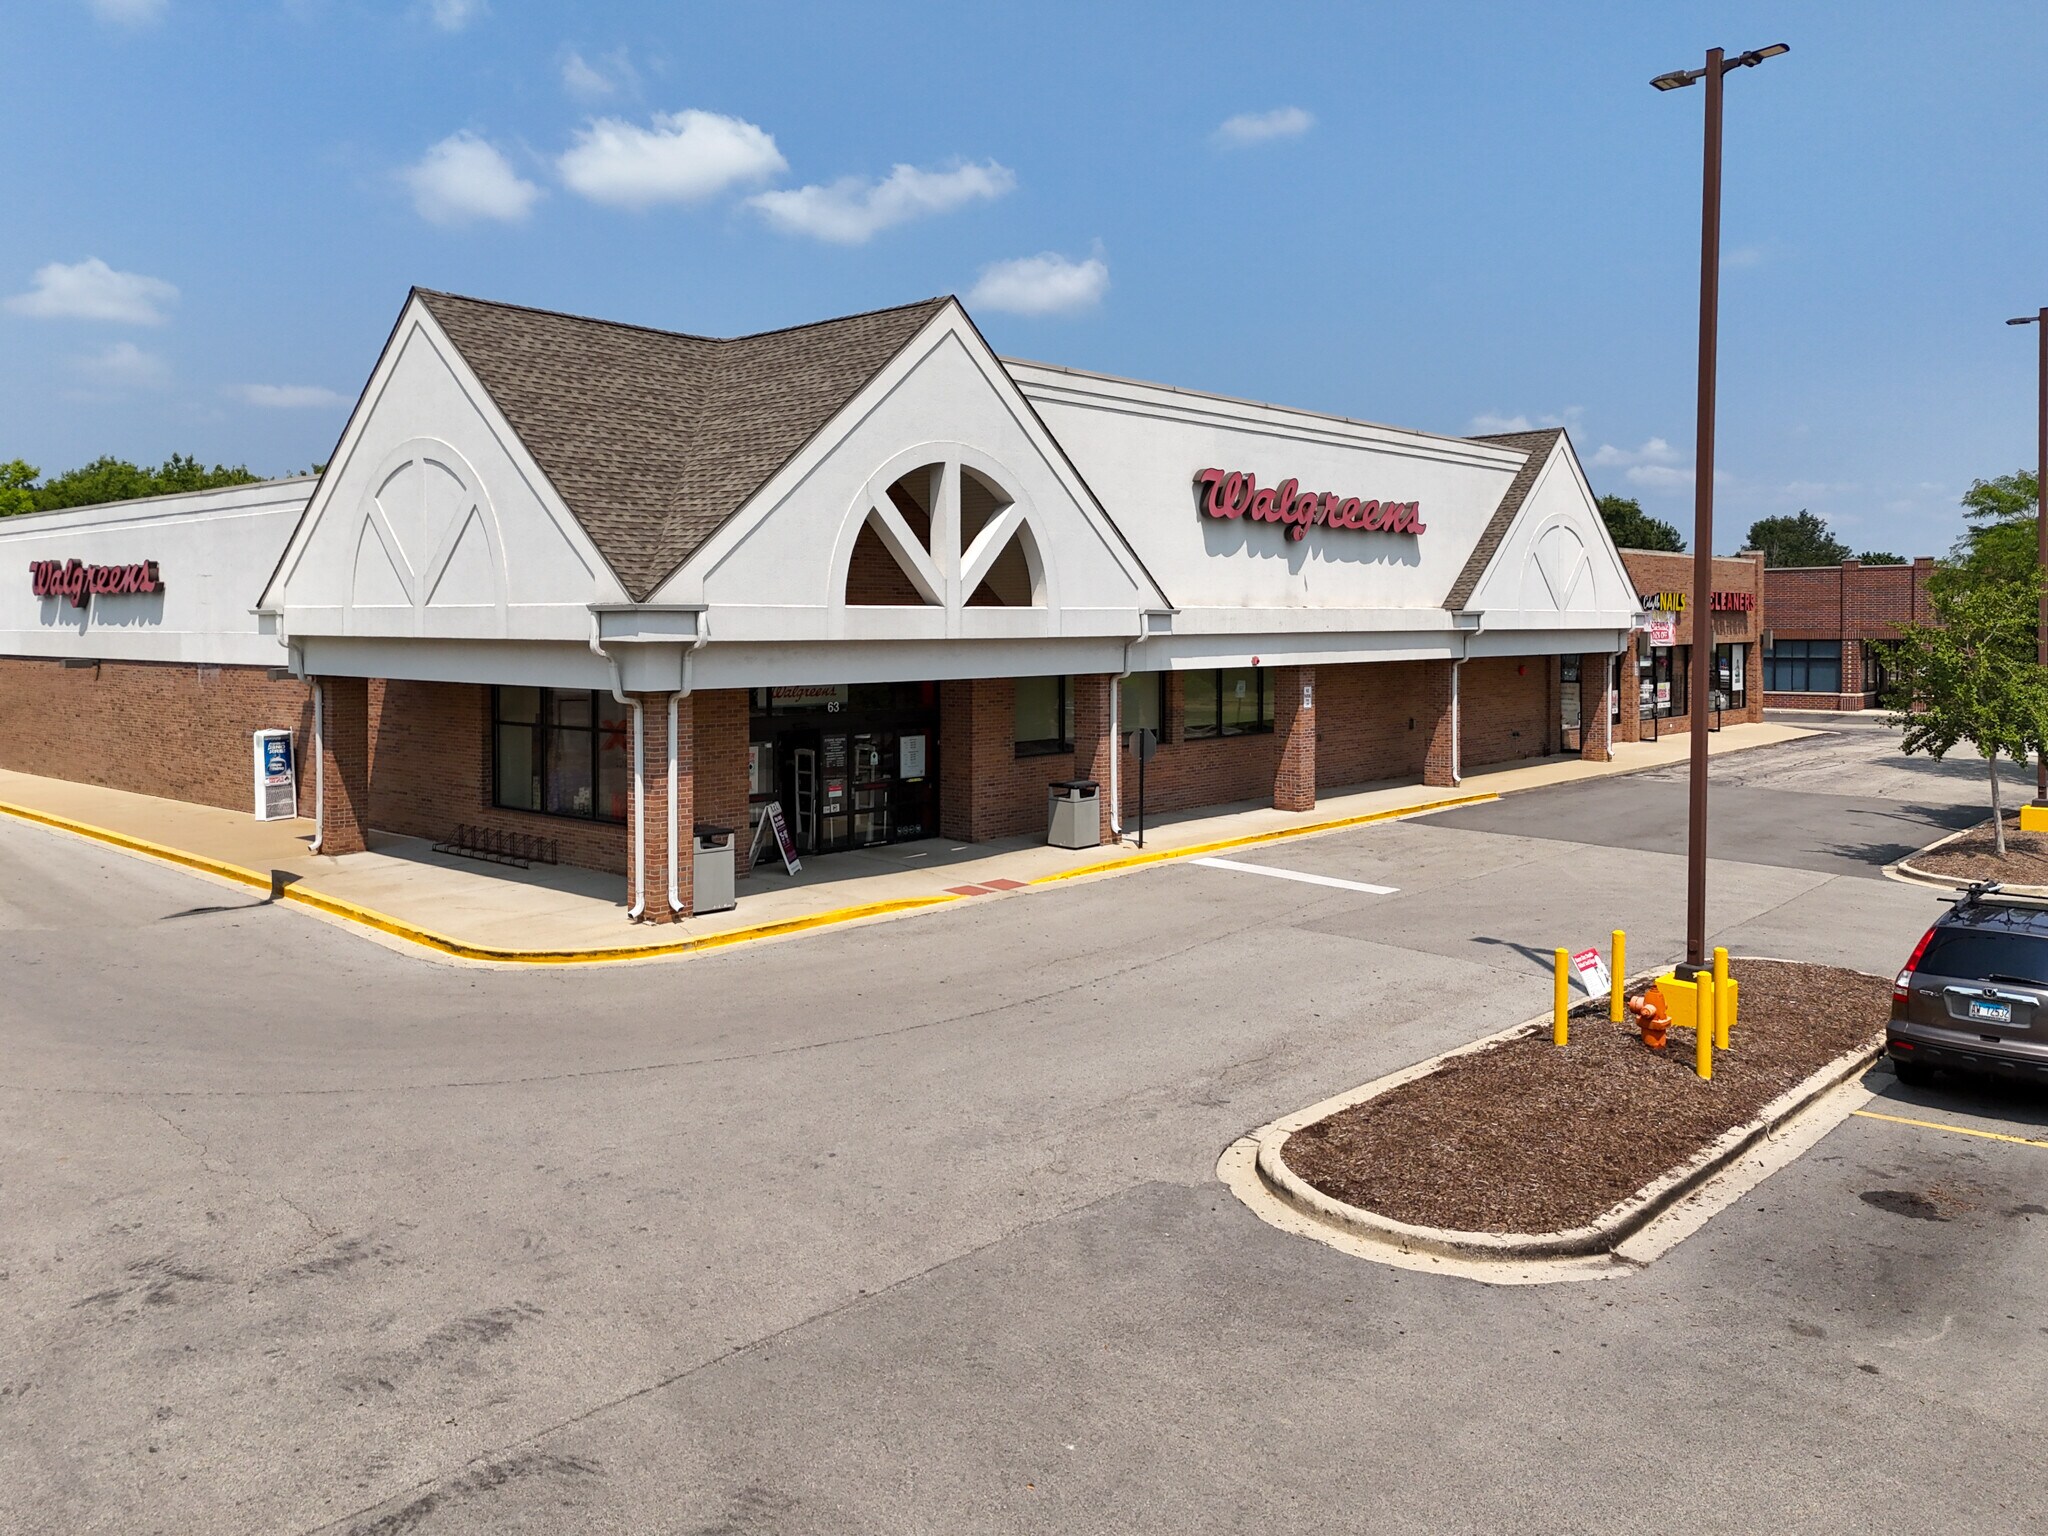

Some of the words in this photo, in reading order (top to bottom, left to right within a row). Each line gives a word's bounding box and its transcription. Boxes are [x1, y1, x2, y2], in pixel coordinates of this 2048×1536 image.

[1195, 468, 1427, 542] Walgreens
[29, 558, 165, 608] Walgreens
[1660, 592, 1686, 611] NAILS
[771, 686, 837, 702] Walgreens
[827, 701, 840, 713] 63
